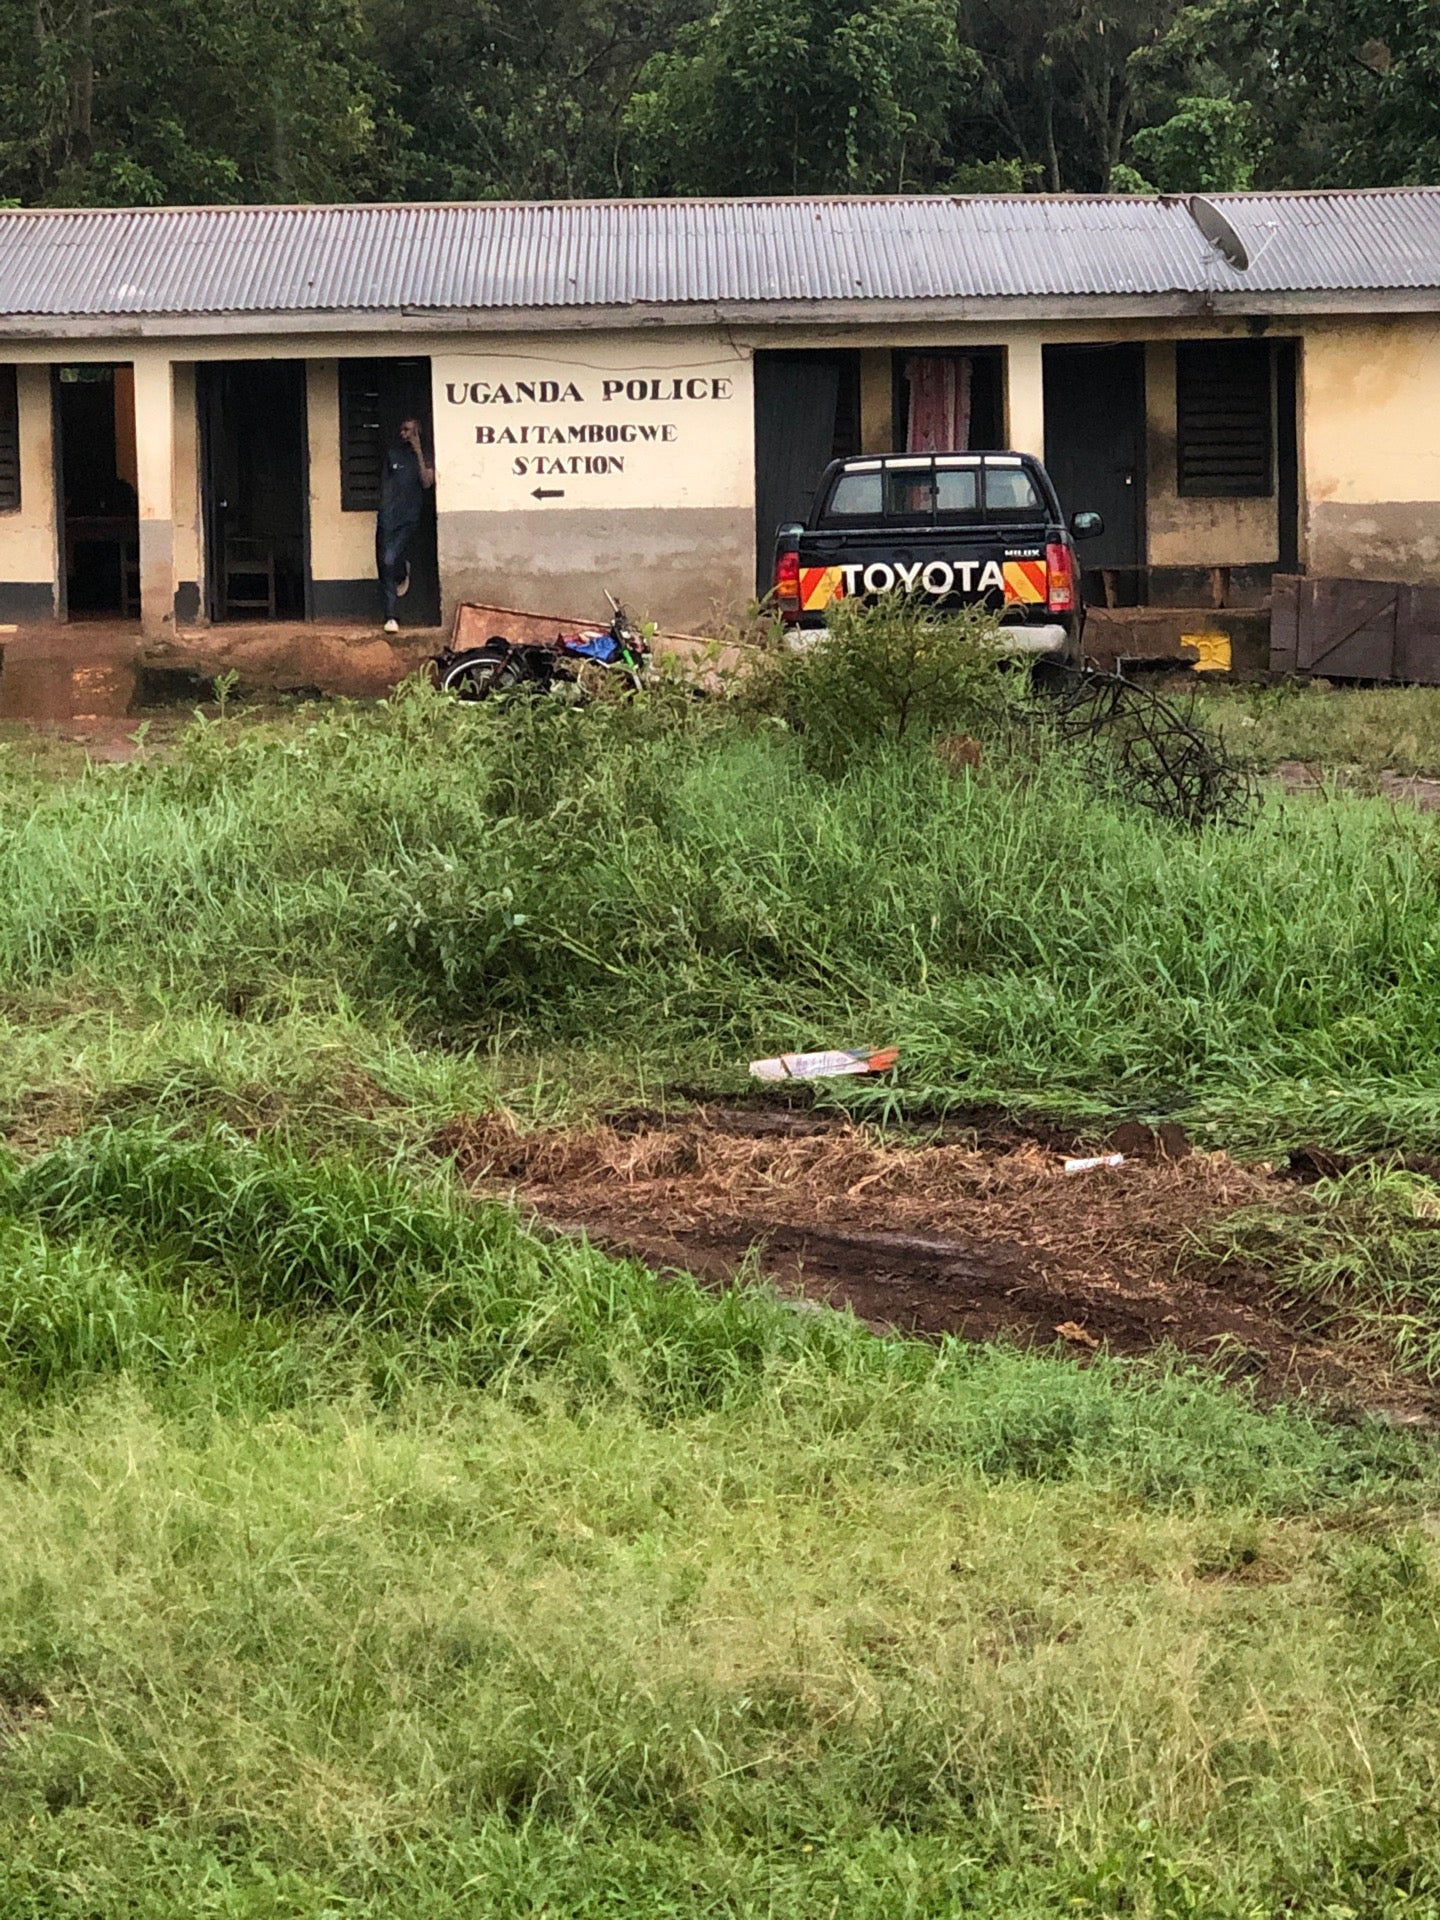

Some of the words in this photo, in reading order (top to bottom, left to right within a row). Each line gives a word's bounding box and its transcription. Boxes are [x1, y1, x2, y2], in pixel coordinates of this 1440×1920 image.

[446, 381, 584, 404] UGANDA
[602, 378, 733, 401] POLICE
[475, 424, 678, 444] BAITAMBOGWE
[512, 456, 624, 475] STATION
[841, 560, 1005, 595] TOYOTA
